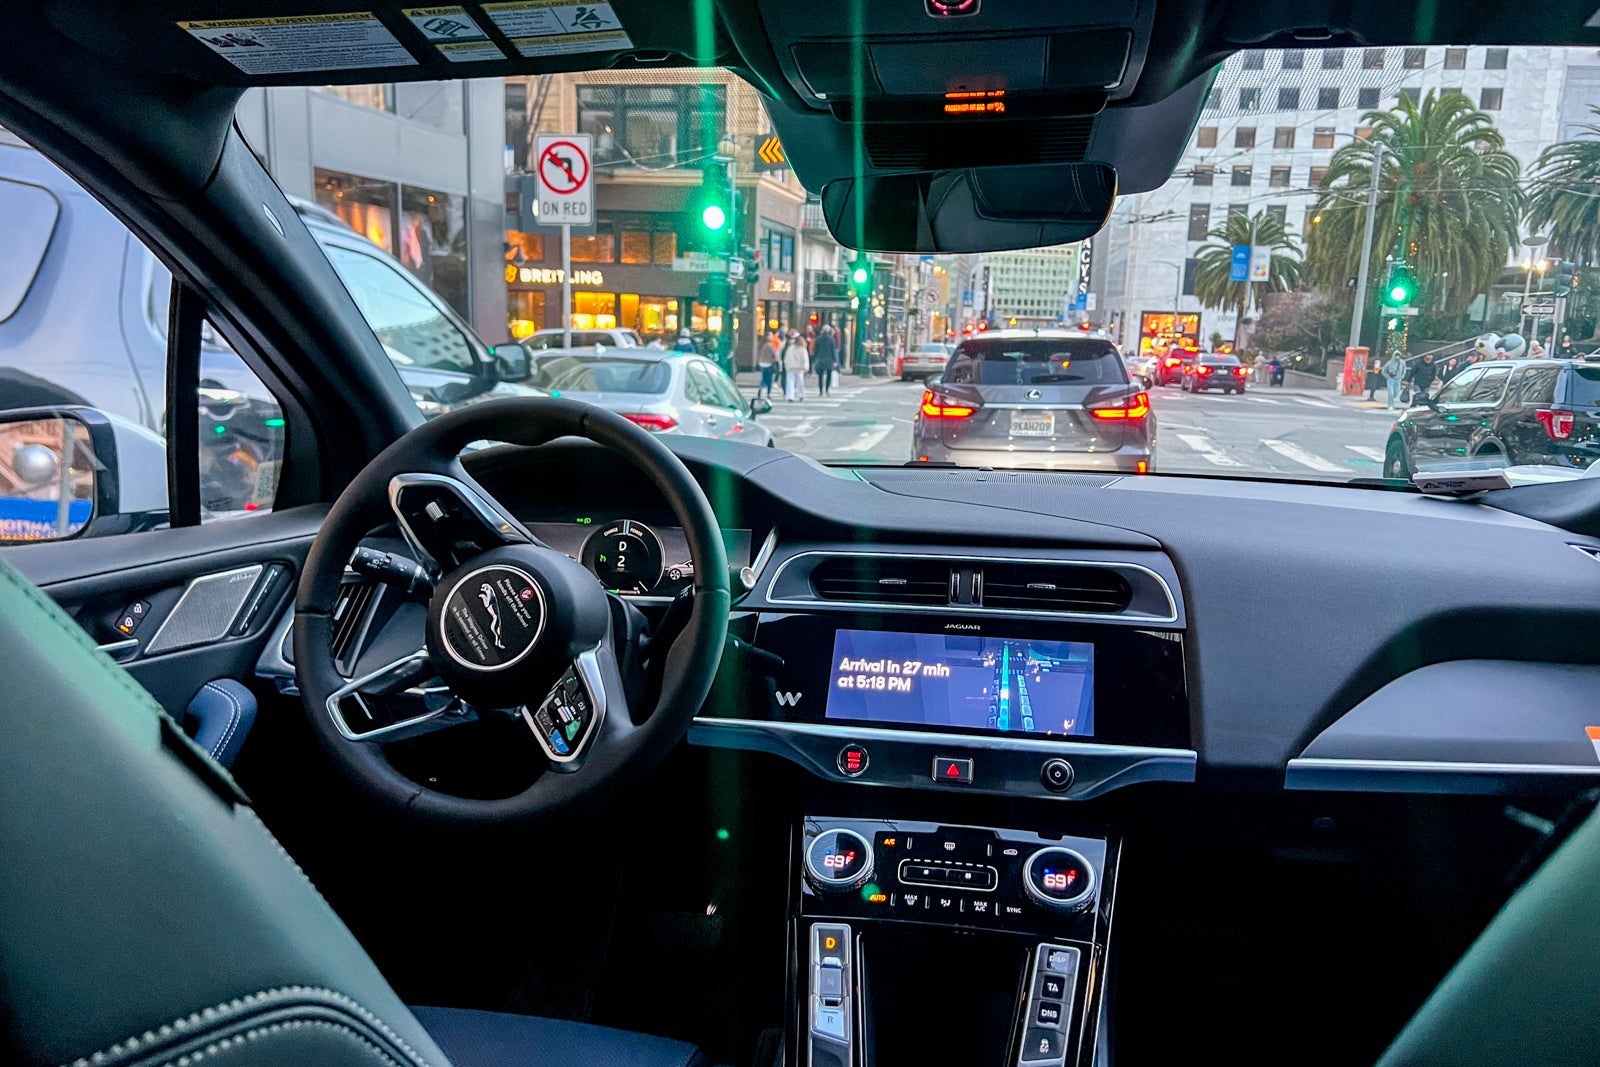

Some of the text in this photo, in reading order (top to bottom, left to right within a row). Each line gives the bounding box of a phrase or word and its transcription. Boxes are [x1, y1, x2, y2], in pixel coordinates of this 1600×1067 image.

[542, 201, 588, 216] ON RED
[630, 527, 643, 537] POWER
[618, 541, 627, 551] D
[617, 555, 625, 567] 2
[496, 579, 529, 628] hands off the wheel
[504, 578, 531, 619] Please keep your
[467, 616, 479, 635] Waymo
[477, 634, 488, 650] Driver
[944, 623, 981, 631] JAGUAR
[839, 657, 950, 677] Arrival in 27 min
[837, 674, 911, 691] at 5:18 PM
[869, 894, 887, 902] AUTO
[1006, 906, 1022, 914] SYNC
[825, 937, 836, 949] D
[1047, 983, 1059, 992] TA
[827, 1016, 834, 1024] R
